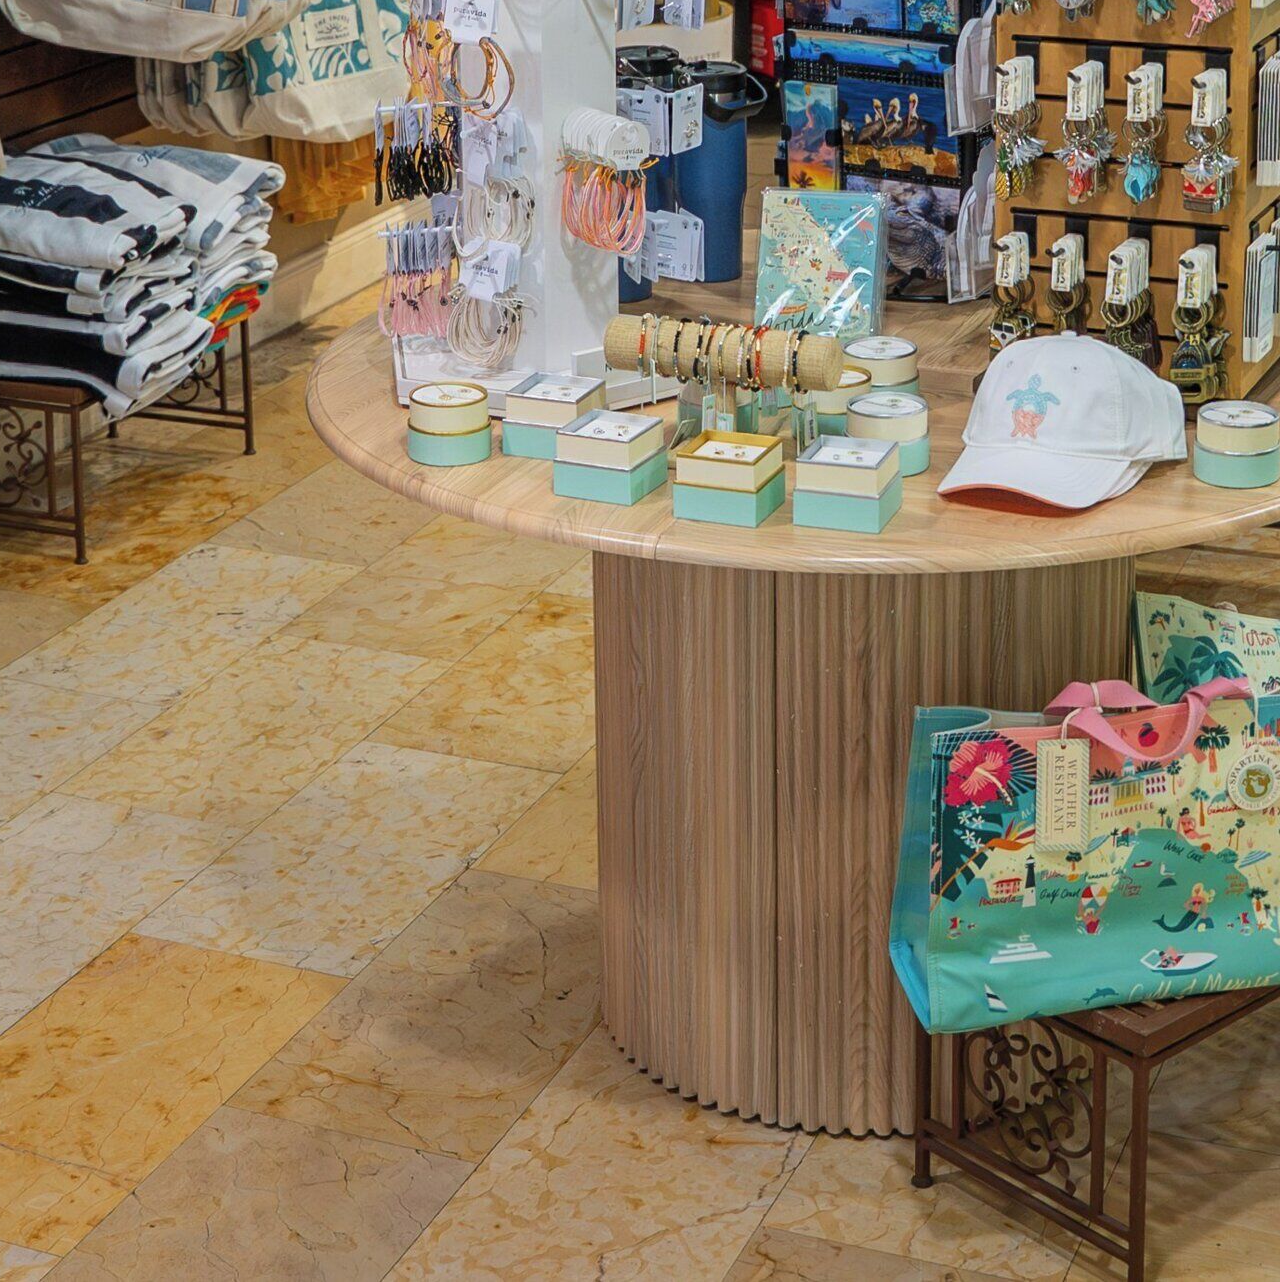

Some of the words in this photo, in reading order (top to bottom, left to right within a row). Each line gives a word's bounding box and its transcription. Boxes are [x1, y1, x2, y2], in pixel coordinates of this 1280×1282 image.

[1054, 755, 1065, 834] RESISTANT
[1067, 759, 1077, 829] WEATHER
[1229, 754, 1271, 785] SPARTINA
